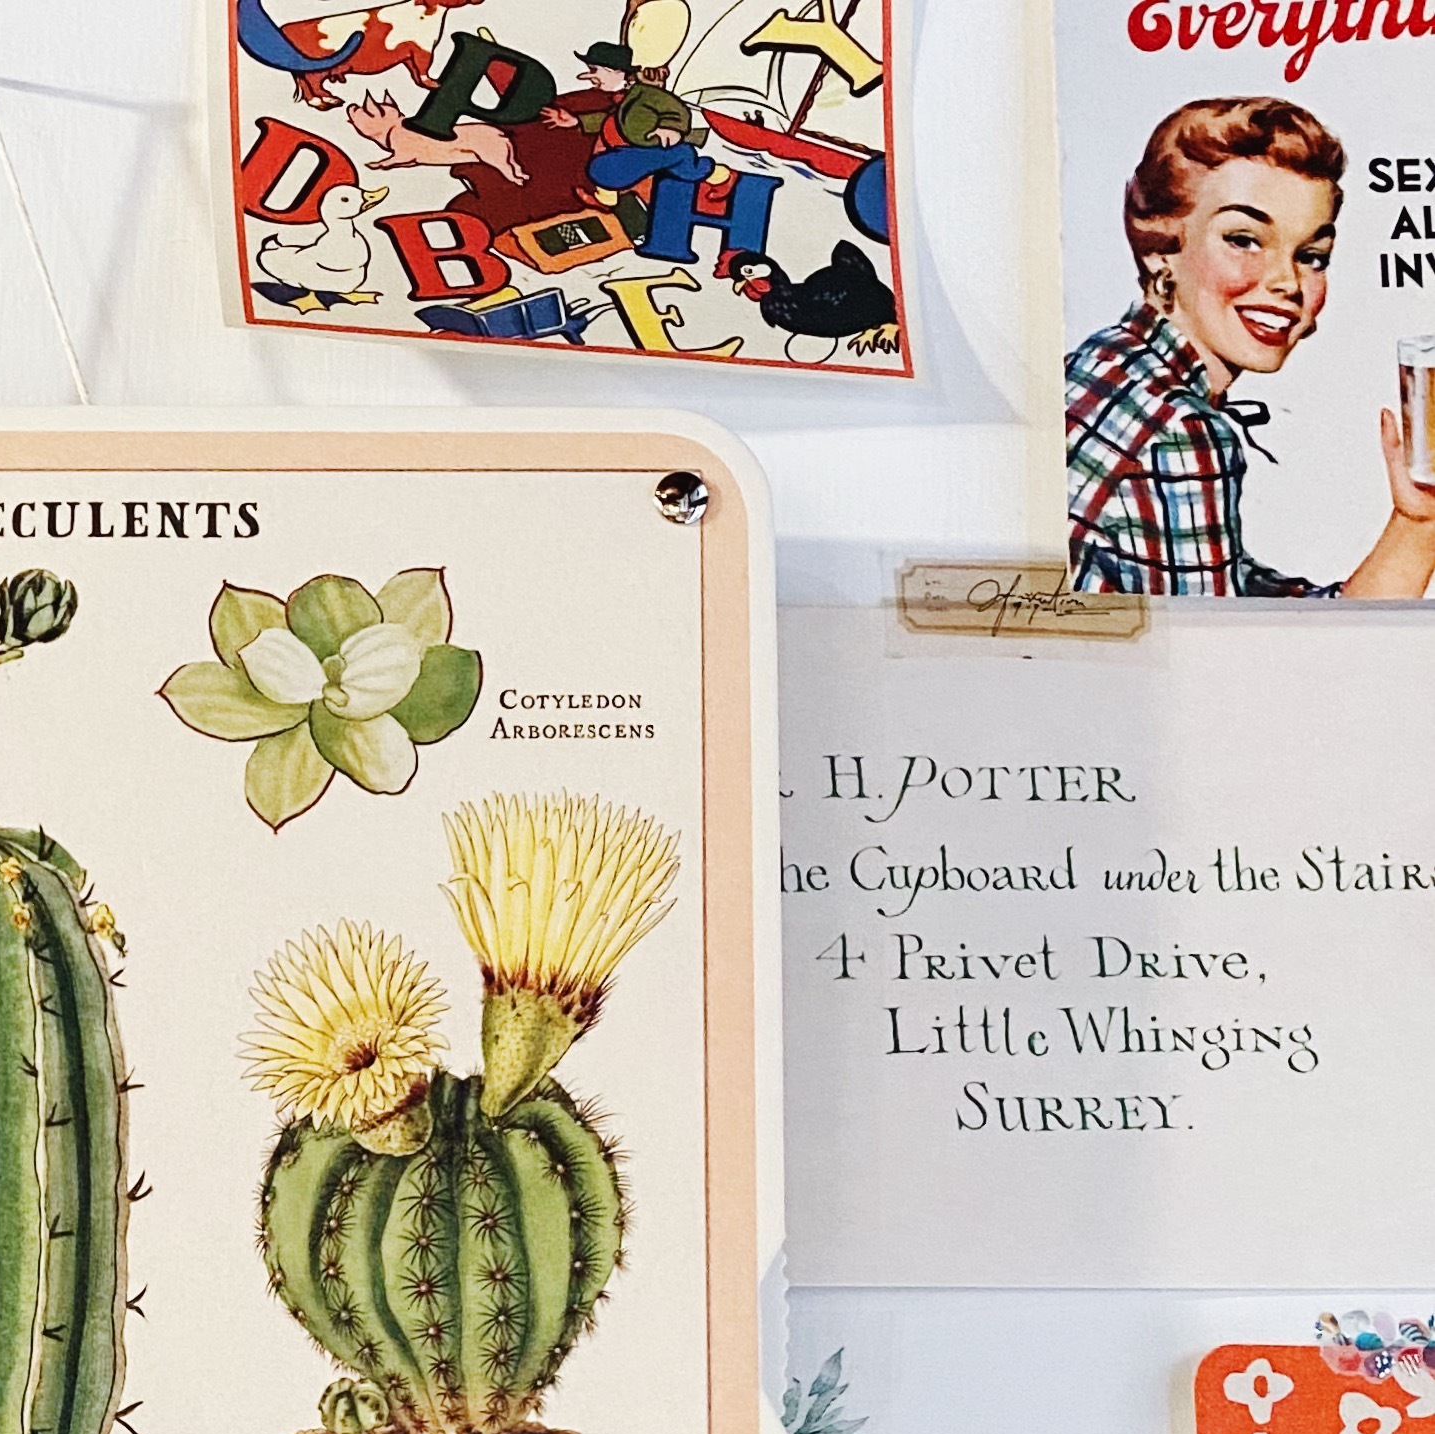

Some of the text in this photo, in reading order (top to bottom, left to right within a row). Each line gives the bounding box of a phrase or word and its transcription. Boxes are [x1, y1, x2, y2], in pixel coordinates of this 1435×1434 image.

[374, 211, 511, 301] B
[499, 689, 642, 709] COTYLEDON
[490, 717, 655, 739] ARBORESCENS
[1103, 847, 1202, 894] under
[1215, 846, 1280, 892] the
[1294, 843, 1435, 894] Stair
[814, 932, 1267, 986] 4 Privet Drive,
[885, 1007, 1319, 1074] Little Whinging
